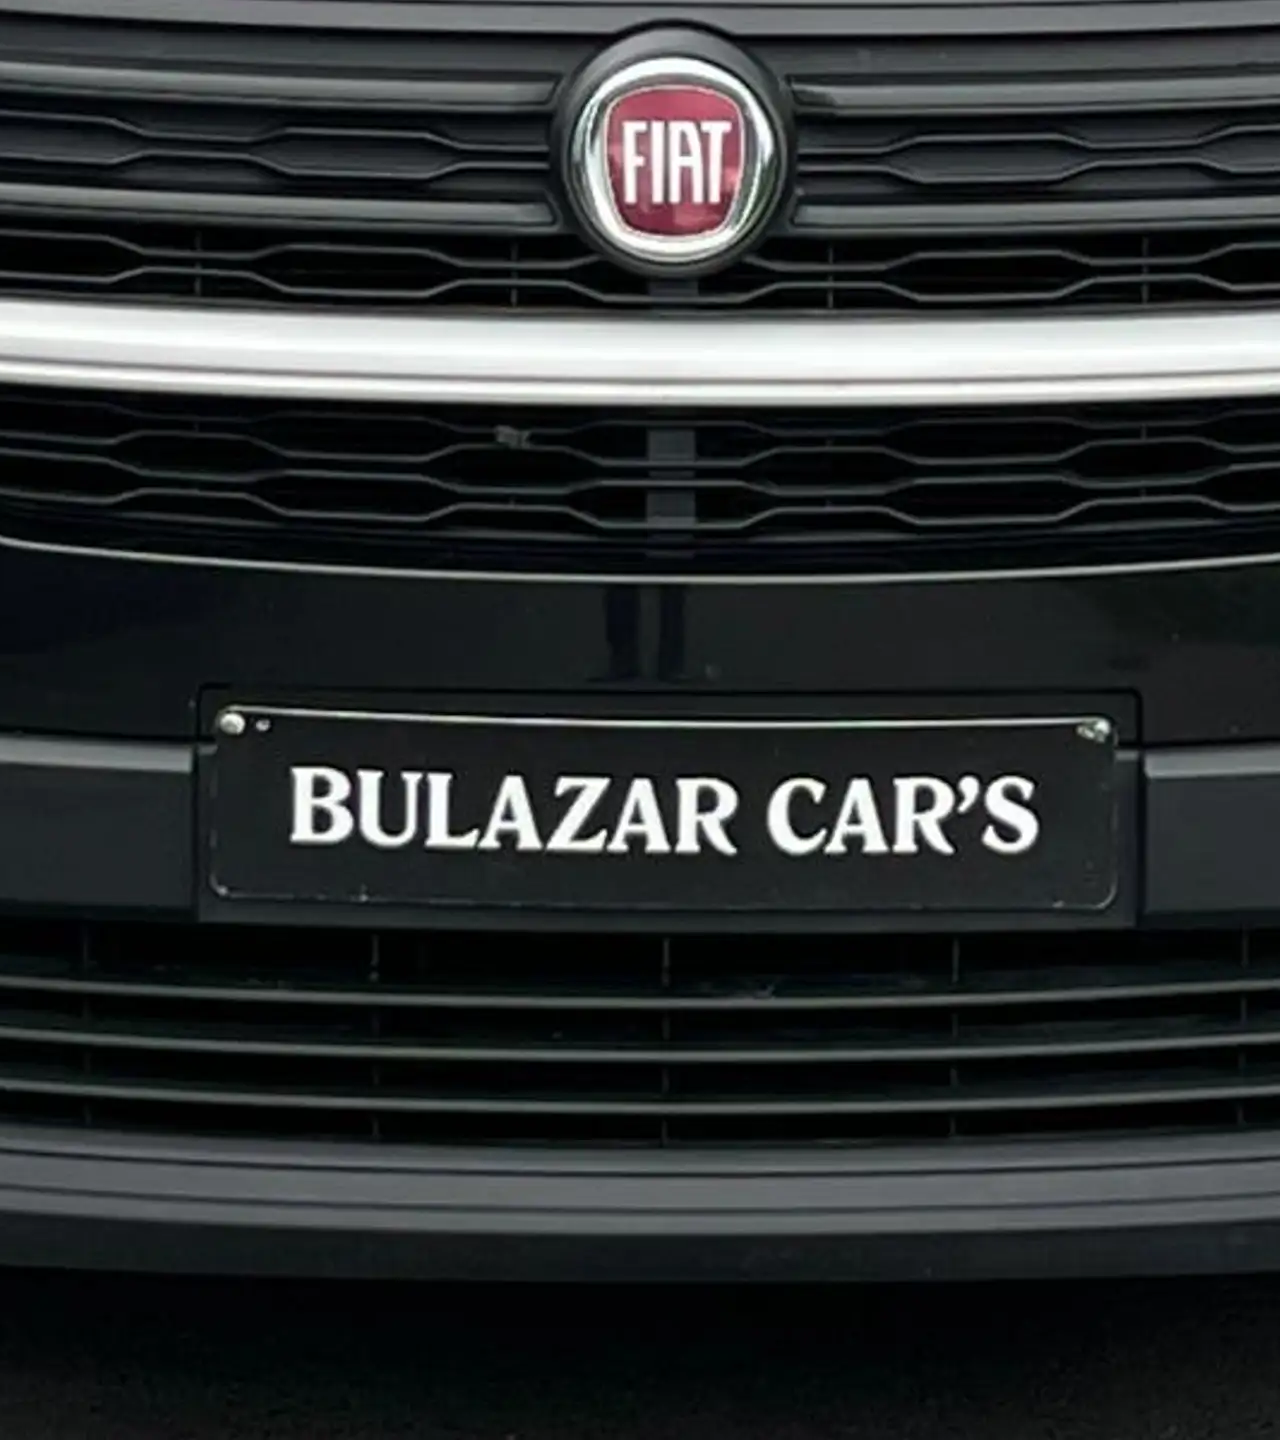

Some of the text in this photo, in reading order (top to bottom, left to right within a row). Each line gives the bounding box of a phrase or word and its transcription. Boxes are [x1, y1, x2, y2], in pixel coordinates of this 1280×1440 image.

[622, 120, 733, 204] FIAT
[289, 766, 1039, 854] BULAZAR CAR'S
